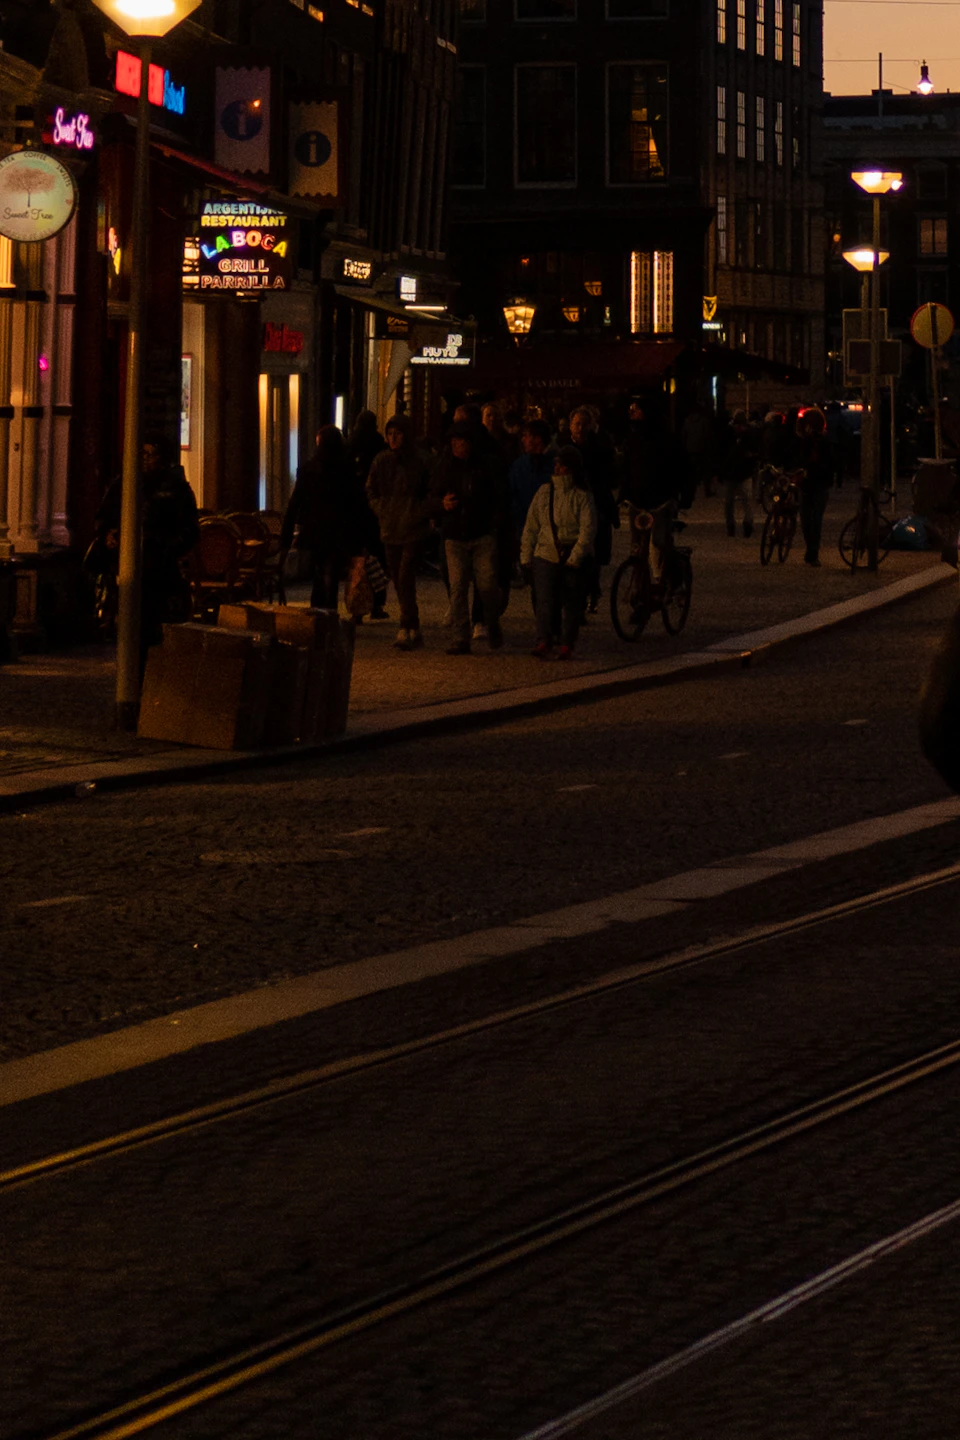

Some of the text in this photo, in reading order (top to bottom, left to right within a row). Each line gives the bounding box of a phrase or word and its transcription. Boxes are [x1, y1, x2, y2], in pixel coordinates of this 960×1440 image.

[23, 151, 47, 162] COFFEE
[55, 164, 72, 188] SWEETS
[3, 207, 54, 220] Sweet Tree
[201, 215, 287, 227] RESTAURANT
[201, 230, 288, 259] LA BOCA
[218, 258, 269, 273] GRILL
[201, 275, 285, 289] PARRILLA
